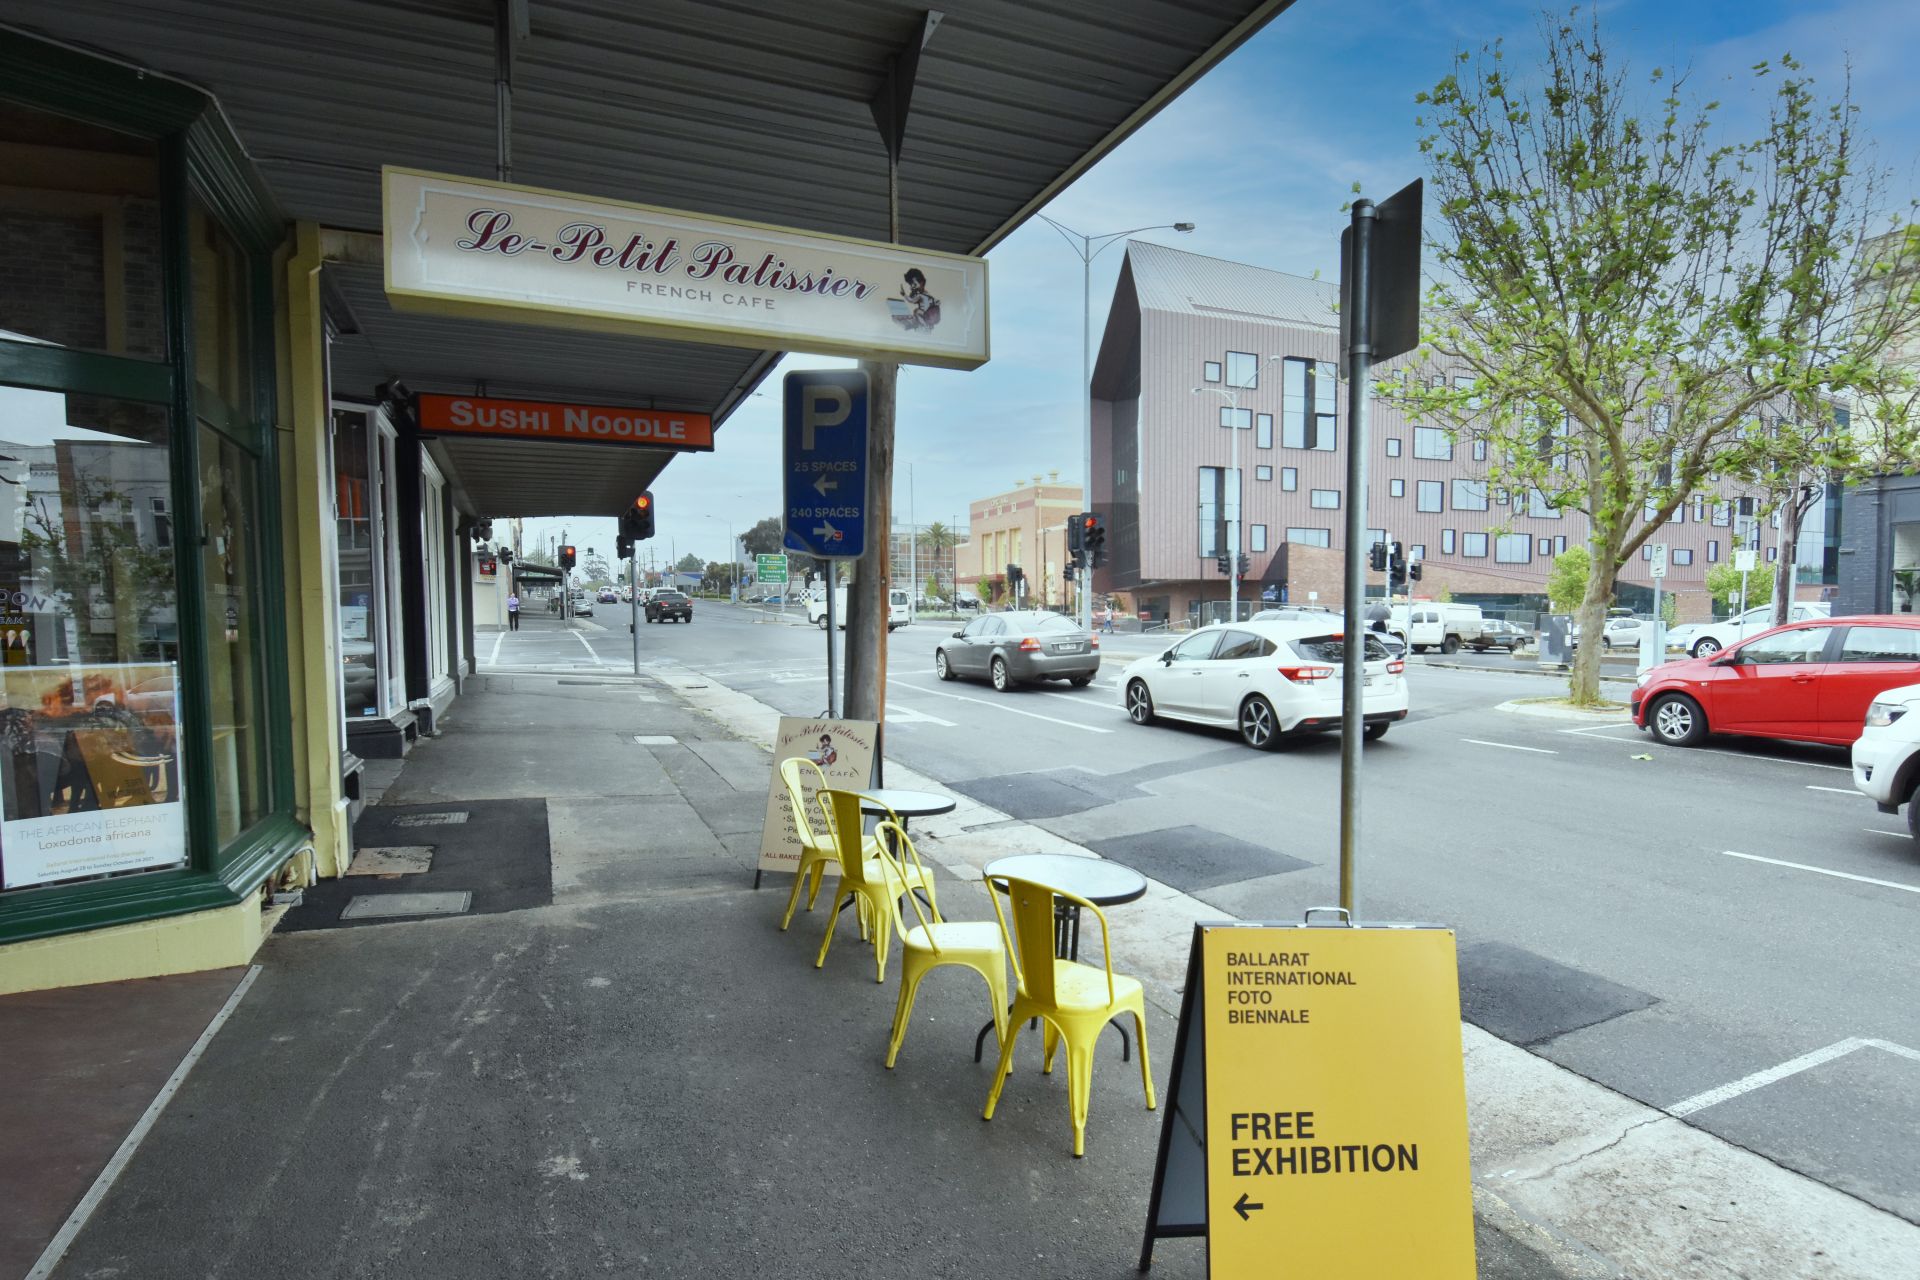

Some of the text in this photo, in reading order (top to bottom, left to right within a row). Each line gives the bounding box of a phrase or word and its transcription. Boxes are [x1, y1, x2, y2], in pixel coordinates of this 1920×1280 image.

[457, 209, 876, 299] Le-Petit Patissier
[627, 281, 775, 309] FRENCH CAFE
[450, 401, 686, 439] SUSHI NOODLE
[802, 384, 852, 450] P
[794, 461, 857, 472] 25 SPACES
[791, 507, 860, 518] 240 SPACES
[20, 814, 168, 840] THE AFRICAN ELEPHANT
[38, 828, 151, 850] Loxodonta africana
[1227, 952, 1310, 966] BALLARAT
[1227, 971, 1356, 985] INTERNATIONAL
[1228, 991, 1272, 1004] FOTO
[1228, 1010, 1310, 1024] BIENNALE
[1231, 1111, 1315, 1140] FREE
[1232, 1144, 1419, 1176] EXHIBITION
